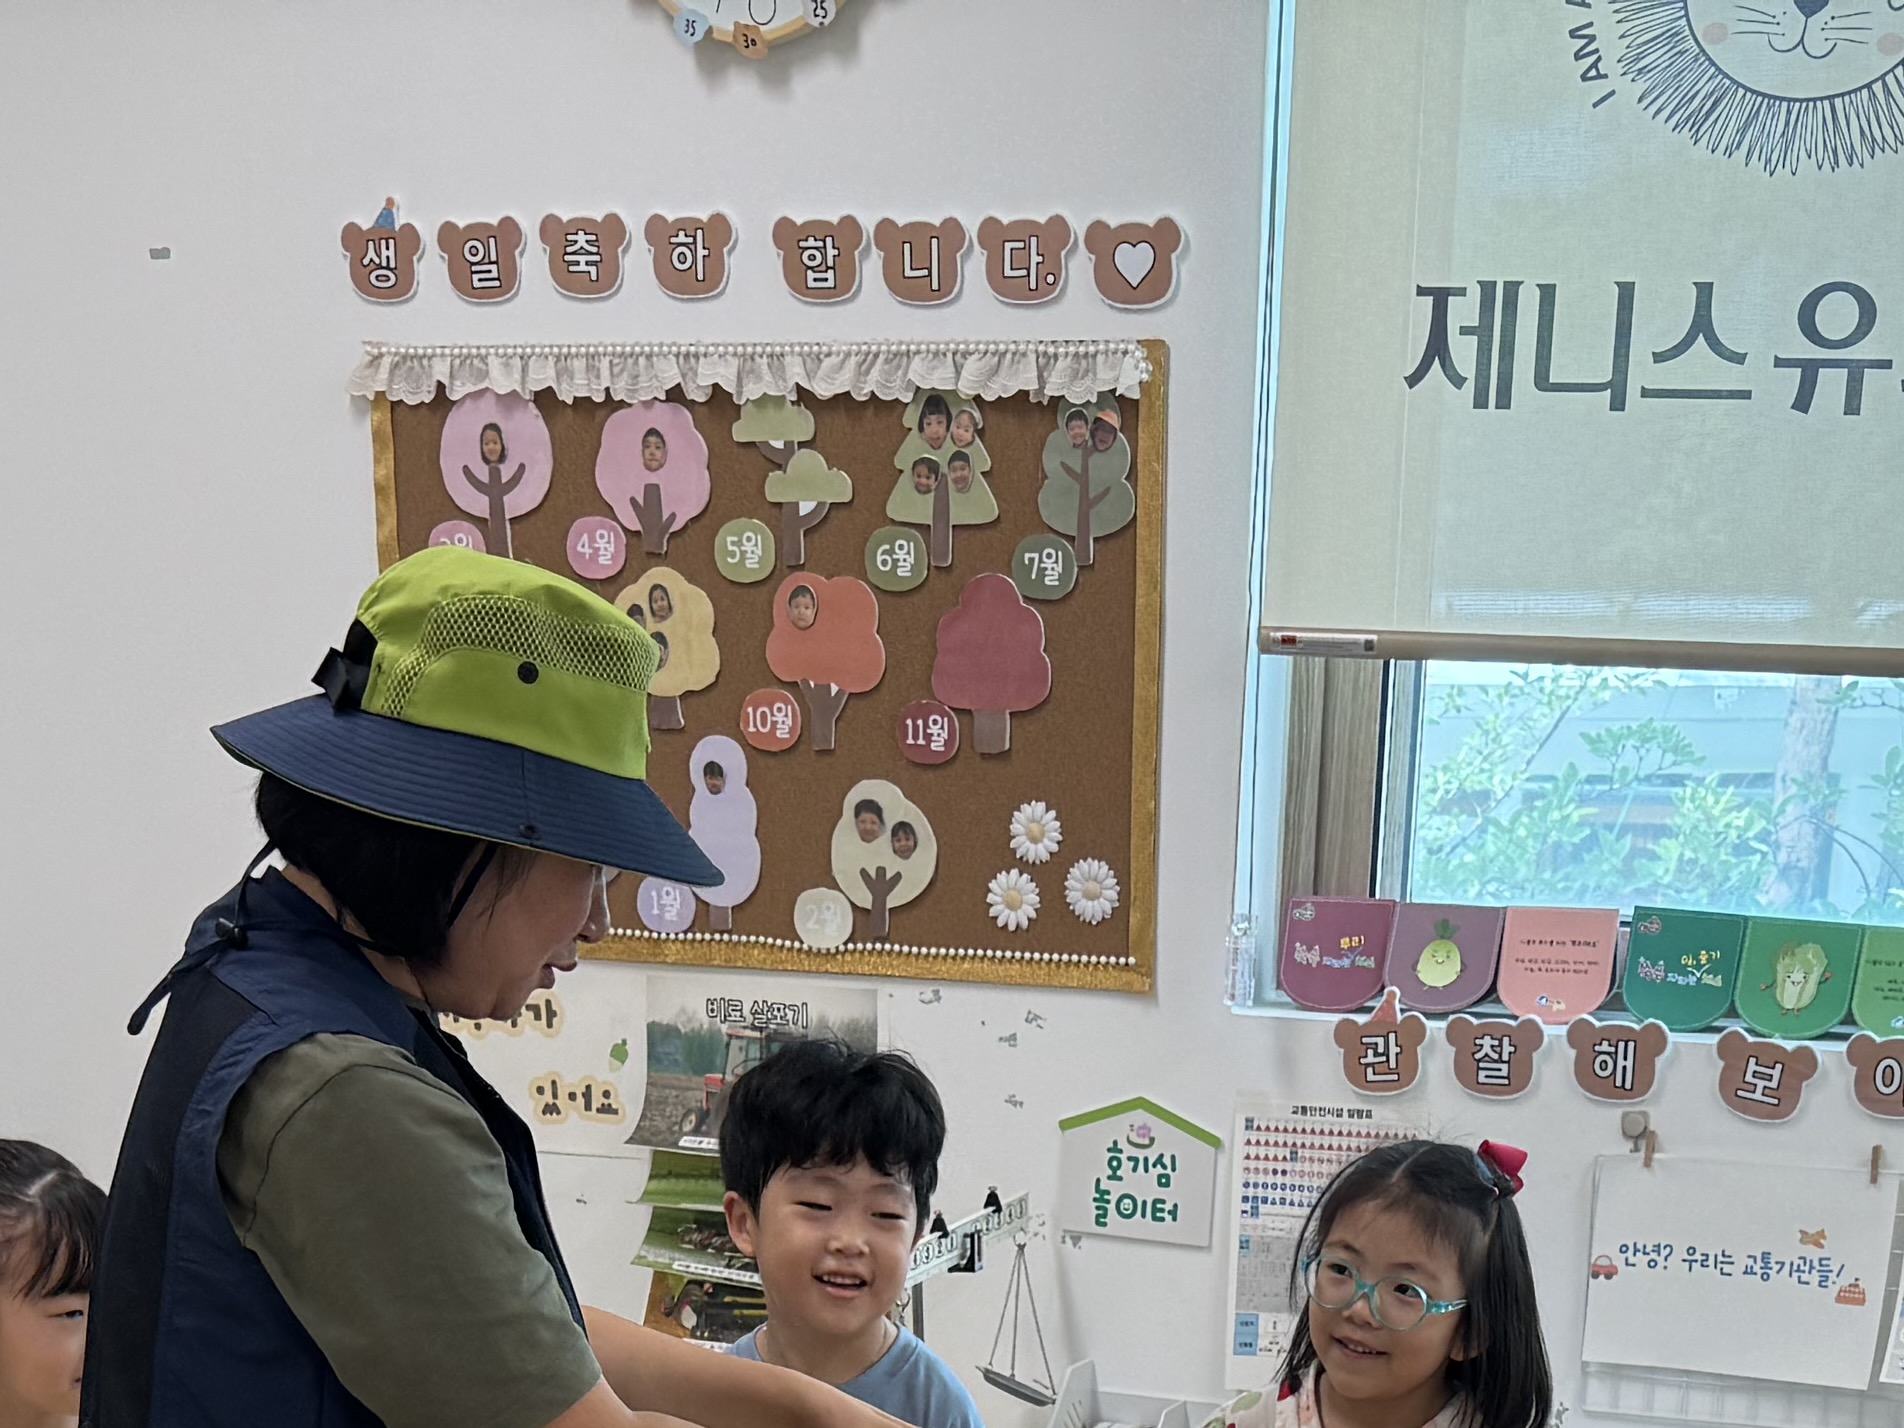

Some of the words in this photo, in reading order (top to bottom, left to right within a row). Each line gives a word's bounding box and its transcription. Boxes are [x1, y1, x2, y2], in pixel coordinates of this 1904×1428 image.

[685, 19, 696, 36] 35
[1568, 21, 1609, 82] AM
[576, 529, 615, 565] 4월
[726, 531, 762, 568] 5월
[876, 539, 915, 577] 6월
[1024, 548, 1063, 586] 7월
[747, 703, 794, 739] 10월
[905, 714, 949, 751] 11월
[651, 887, 681, 921] 1월
[806, 904, 842, 935] 2월
[706, 997, 746, 1024] 비료
[750, 1000, 808, 1030] 살포기
[535, 1059, 620, 1117] 있어요
[1105, 1140, 1177, 1189] 호기심
[1092, 1177, 1179, 1228] 놀이터
[1618, 1241, 1673, 1271] 안녕?
[1681, 1245, 1735, 1276] 우리는
[1742, 1251, 1845, 1289] 교통기관들!
